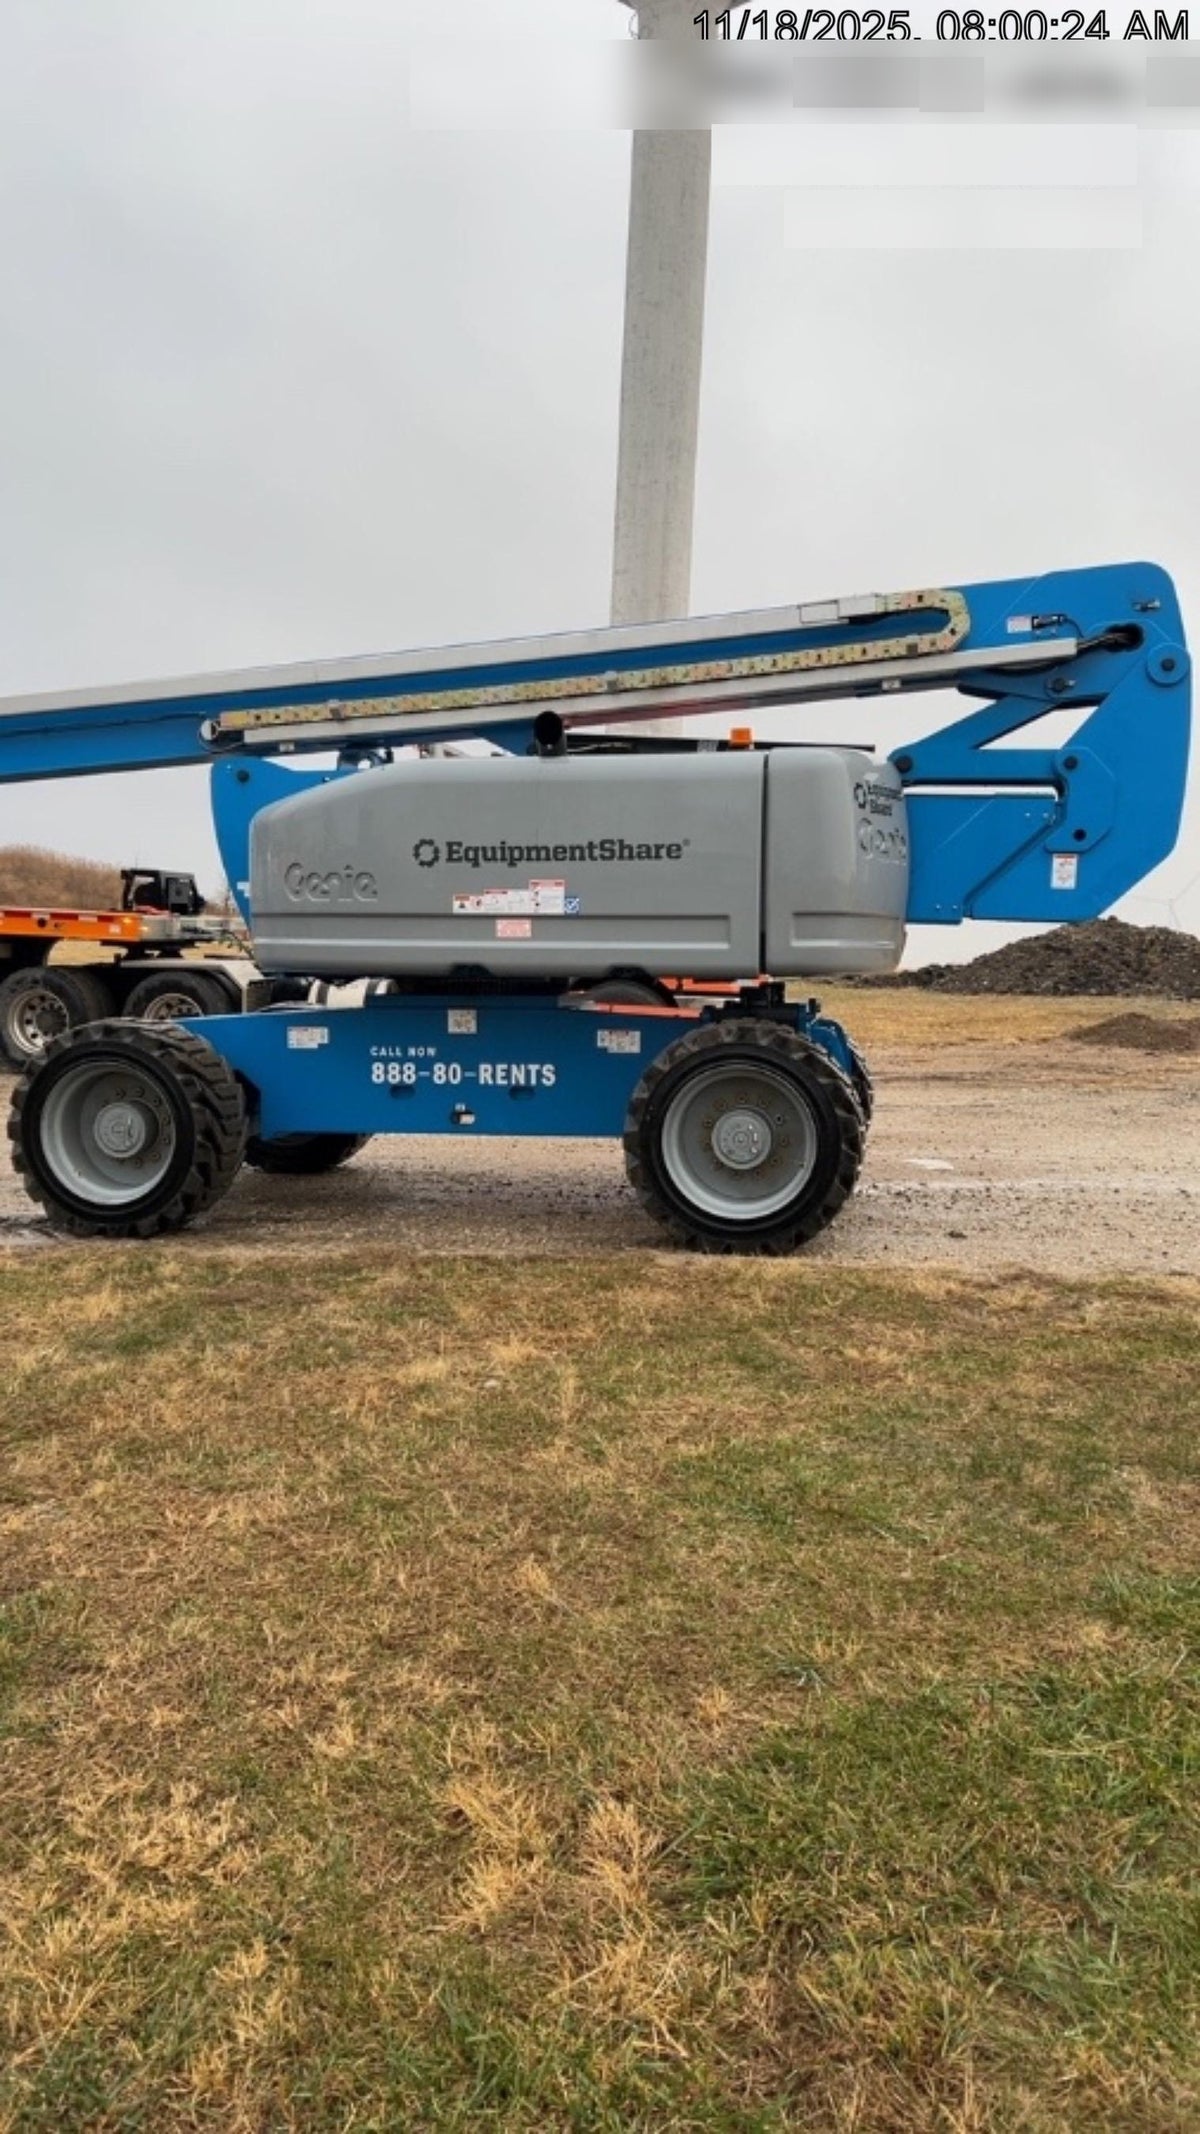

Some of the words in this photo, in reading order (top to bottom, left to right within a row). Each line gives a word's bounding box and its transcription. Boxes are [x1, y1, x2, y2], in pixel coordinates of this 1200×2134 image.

[445, 838, 683, 868] EquipmentShare
[284, 862, 378, 902] Genie
[370, 1046, 402, 1057] CALL
[407, 1046, 437, 1057] NOW
[371, 1061, 556, 1087] 888-80-RENTS
